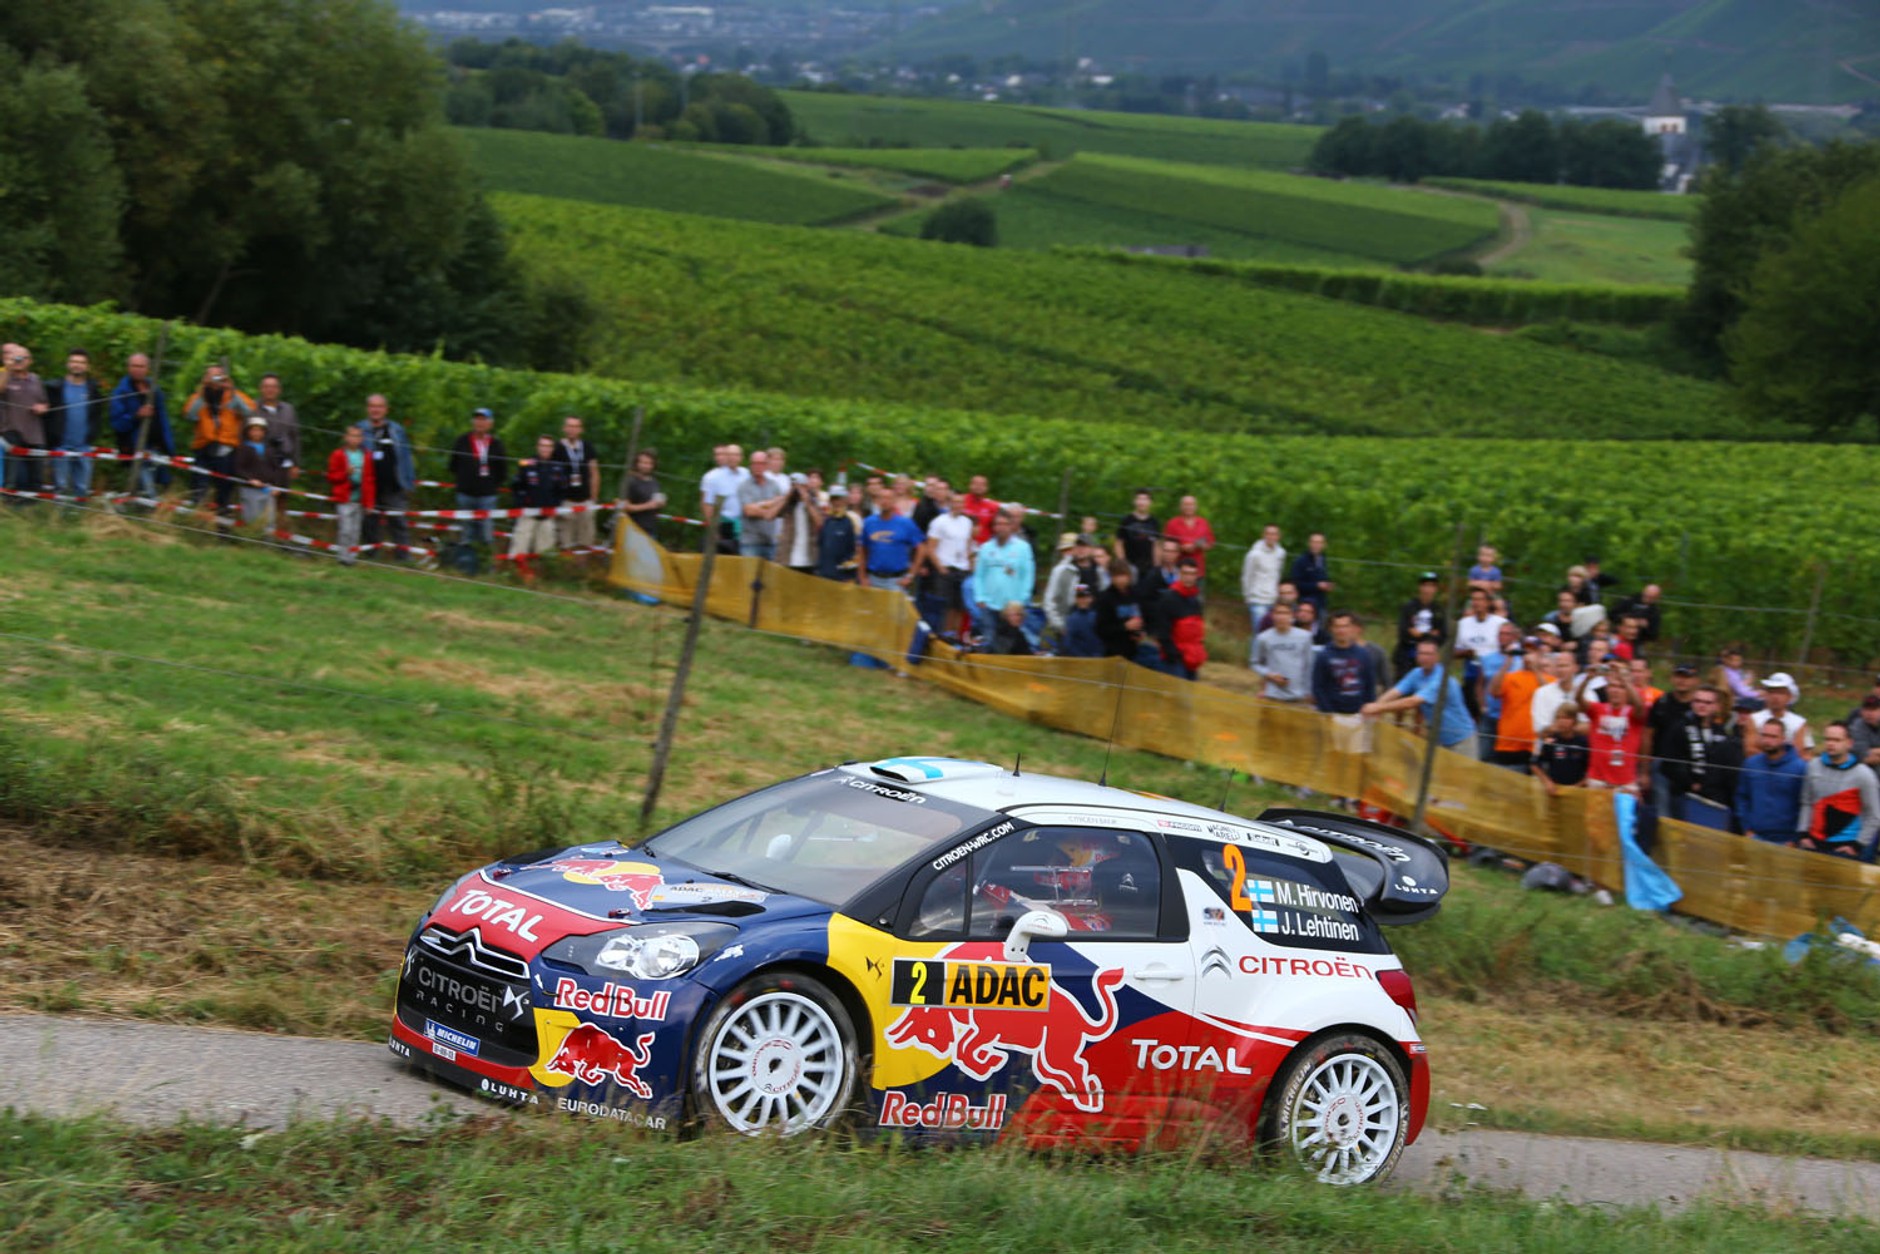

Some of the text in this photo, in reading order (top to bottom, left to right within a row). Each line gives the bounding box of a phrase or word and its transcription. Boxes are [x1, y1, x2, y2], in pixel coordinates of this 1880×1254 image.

[933, 821, 1014, 871] CITROEN-WRC.COM
[1223, 843, 1253, 912] 2
[1276, 881, 1360, 914] M. Hirvonen
[450, 889, 544, 943] TOTAL
[1281, 912, 1360, 941] J. Lehtinen
[910, 961, 1045, 1007] 2 ADAC
[436, 1028, 477, 1051] MICHELIN
[1132, 1039, 1251, 1075] TOTAL
[491, 1084, 538, 1105] LUHTA
[1282, 1063, 1312, 1123] MICHELIN
[558, 1097, 667, 1130] EURODATACAR
